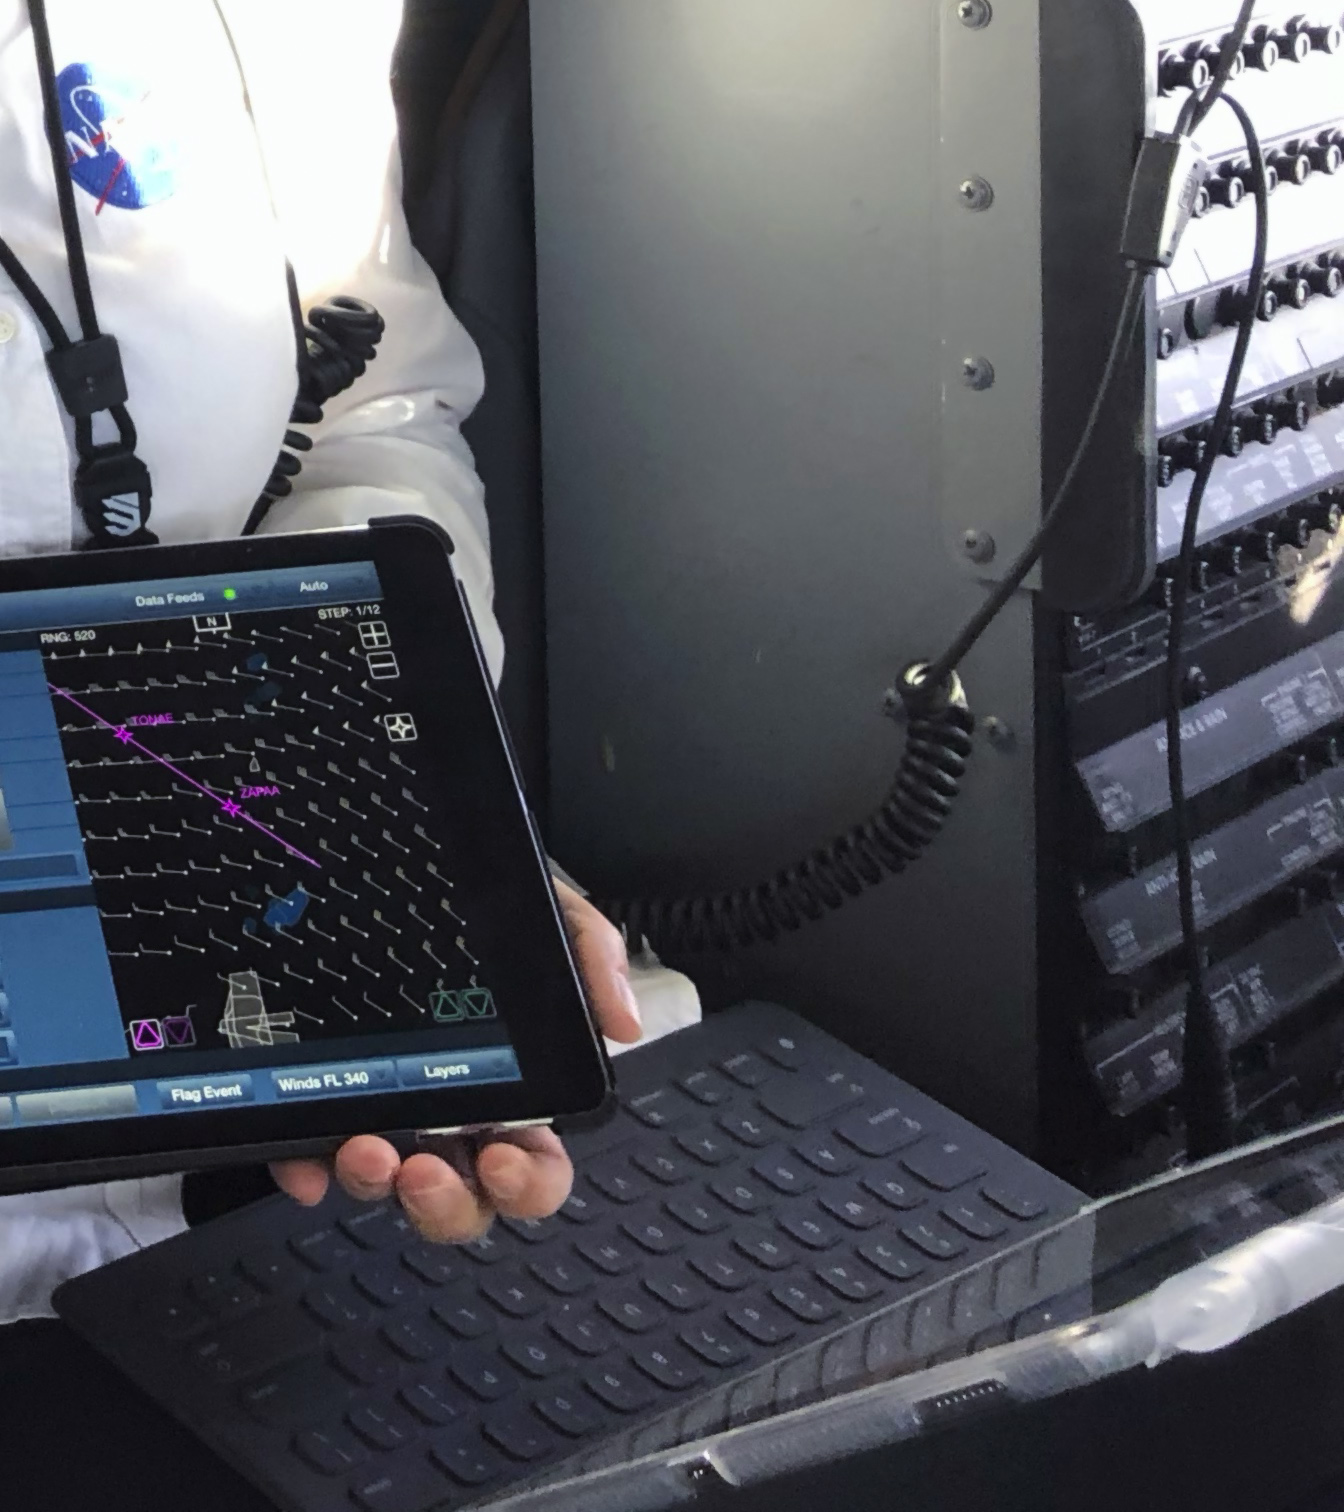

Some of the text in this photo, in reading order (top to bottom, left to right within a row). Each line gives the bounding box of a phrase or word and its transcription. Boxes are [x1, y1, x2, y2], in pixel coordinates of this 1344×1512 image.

[299, 580, 329, 593] Auto
[135, 591, 205, 607] Data Feeds
[318, 603, 381, 620] STEP: 1/12
[40, 629, 96, 644] RNG: 520
[424, 1062, 470, 1079] Layers
[278, 1071, 369, 1093] Winds FL 340
[171, 1084, 242, 1104] Flag Event
